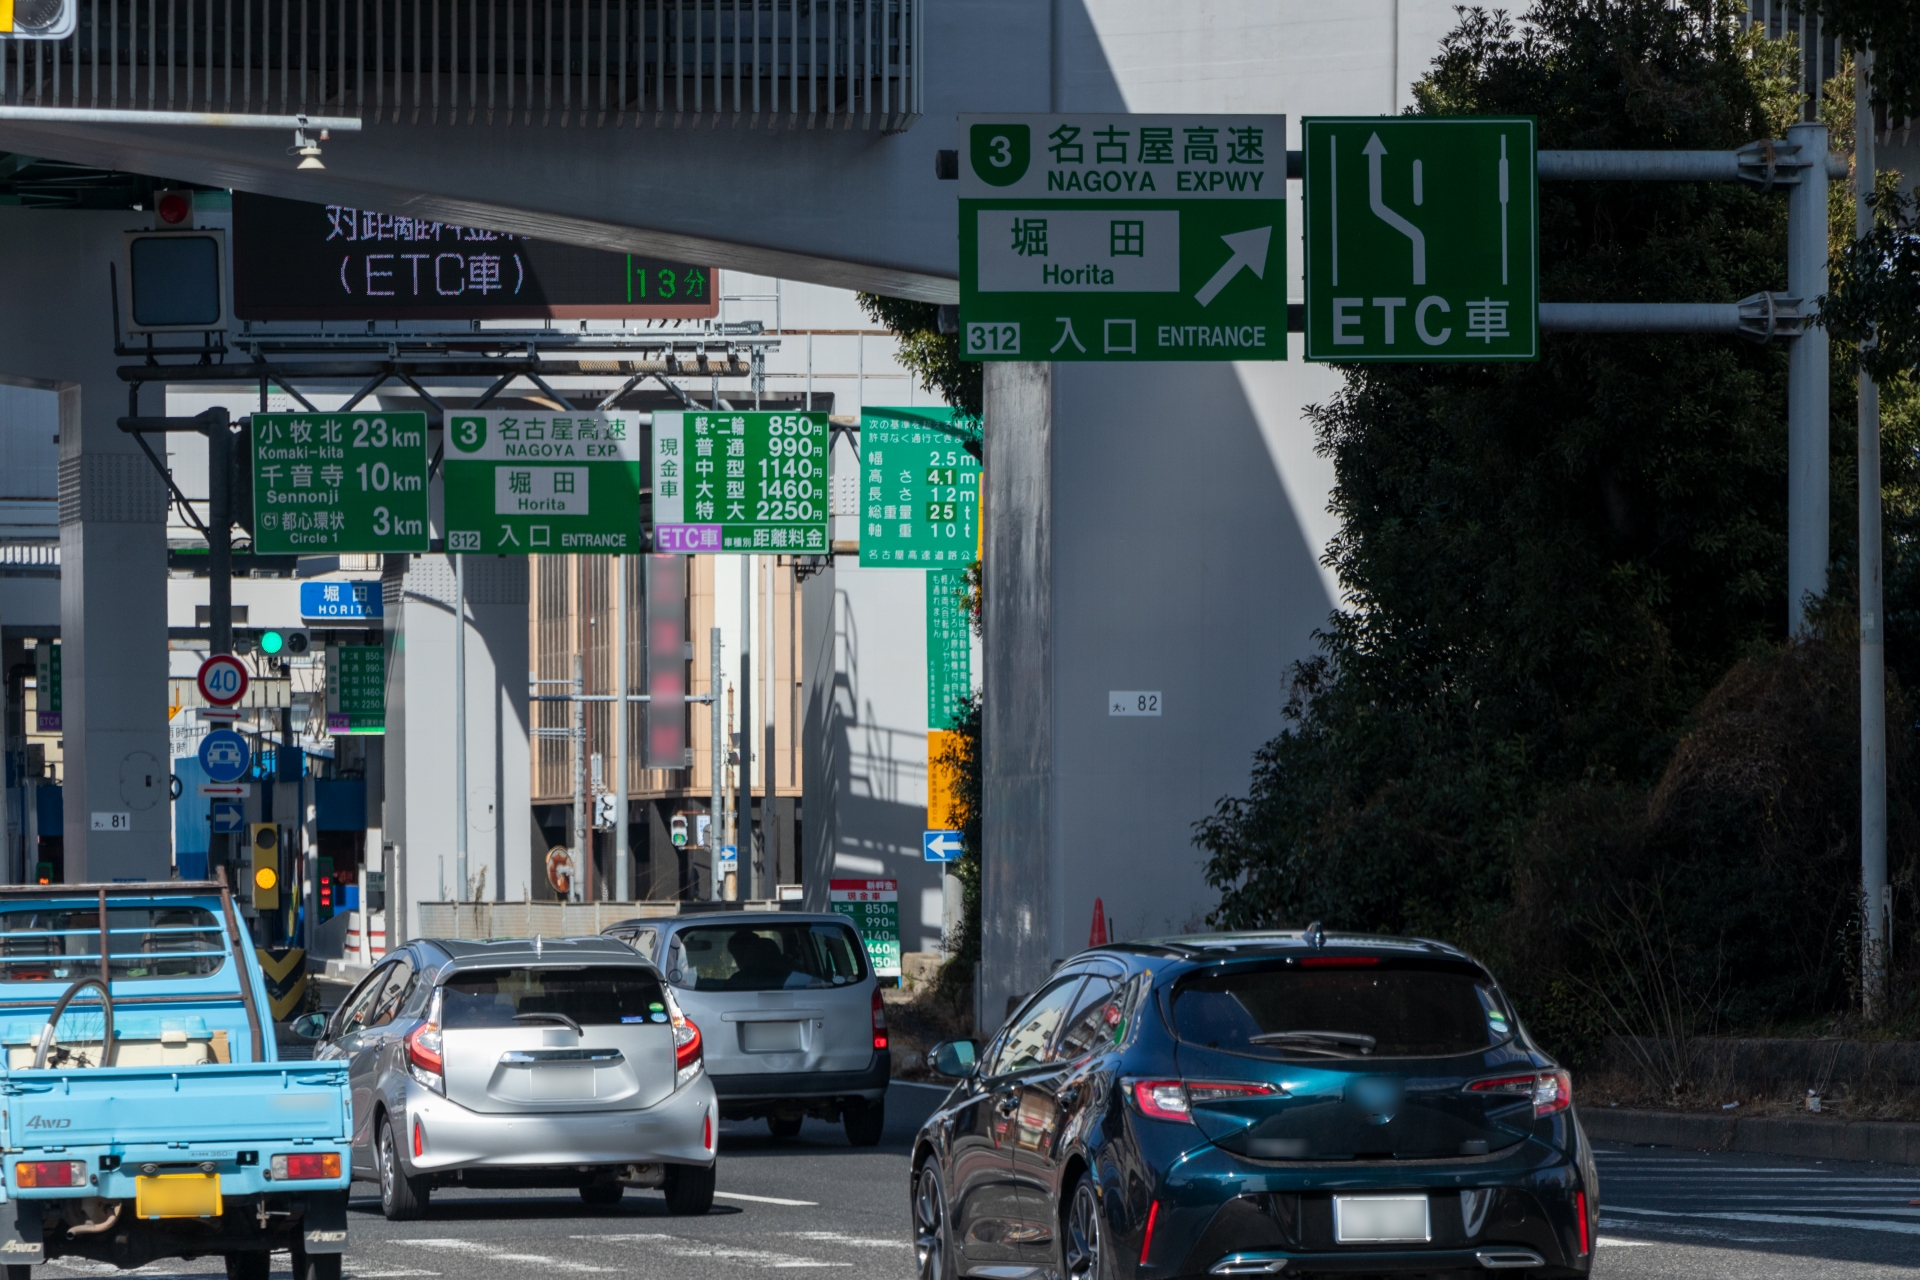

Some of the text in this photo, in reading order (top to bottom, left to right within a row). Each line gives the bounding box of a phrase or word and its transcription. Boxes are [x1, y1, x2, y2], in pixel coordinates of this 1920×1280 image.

[989, 135, 1012, 168] 3
[1048, 124, 1265, 164] 名古屋高速
[1048, 171, 1265, 191] NAGOYA EXPWY
[1011, 217, 1145, 257] 堀田
[1043, 264, 1114, 285] Horita
[1332, 295, 1510, 346] ETC車
[970, 317, 1266, 354] 312 入口 ENTRANCE
[259, 418, 420, 448] 小牧北 23 km
[460, 420, 478, 445] 3
[498, 417, 627, 441] 名古屋高速
[695, 416, 823, 436] 軽・二輪 850円
[259, 446, 344, 459] Komaki-kita
[505, 444, 618, 457] NAGOYA EXP
[695, 437, 823, 457] 普通 990円
[660, 438, 678, 499] 現金車
[695, 458, 823, 478] 中型 1140円
[868, 451, 976, 466] 幅 2.5 m
[261, 462, 421, 491] 千音寺 10 km
[509, 471, 575, 495] 堀田
[868, 469, 976, 486] 高さ 4.1 m
[267, 490, 339, 505] Sennonji
[695, 479, 823, 499] 大型 1460円
[868, 486, 975, 502] 長さ 12 m
[518, 498, 566, 511] Horita
[695, 500, 823, 520] 特大 2250円
[868, 504, 970, 520] 総重量 25 t
[263, 507, 422, 536] C1 都心環状 3 km
[868, 523, 970, 538] 軸重 10 t
[290, 532, 338, 544] Circle 1
[451, 524, 627, 548] 312 入口 ENTRANCE
[658, 527, 718, 548] ETC車
[753, 528, 823, 548] 距離料金
[323, 585, 368, 602] 堀田
[318, 605, 373, 615] HORITA
[209, 669, 237, 692] 40
[1138, 695, 1158, 711] 82
[112, 815, 126, 828] 81
[25, 1115, 71, 1129] 4WD
[306, 1229, 346, 1242] 4WD
[0, 1240, 42, 1253] 4WD
